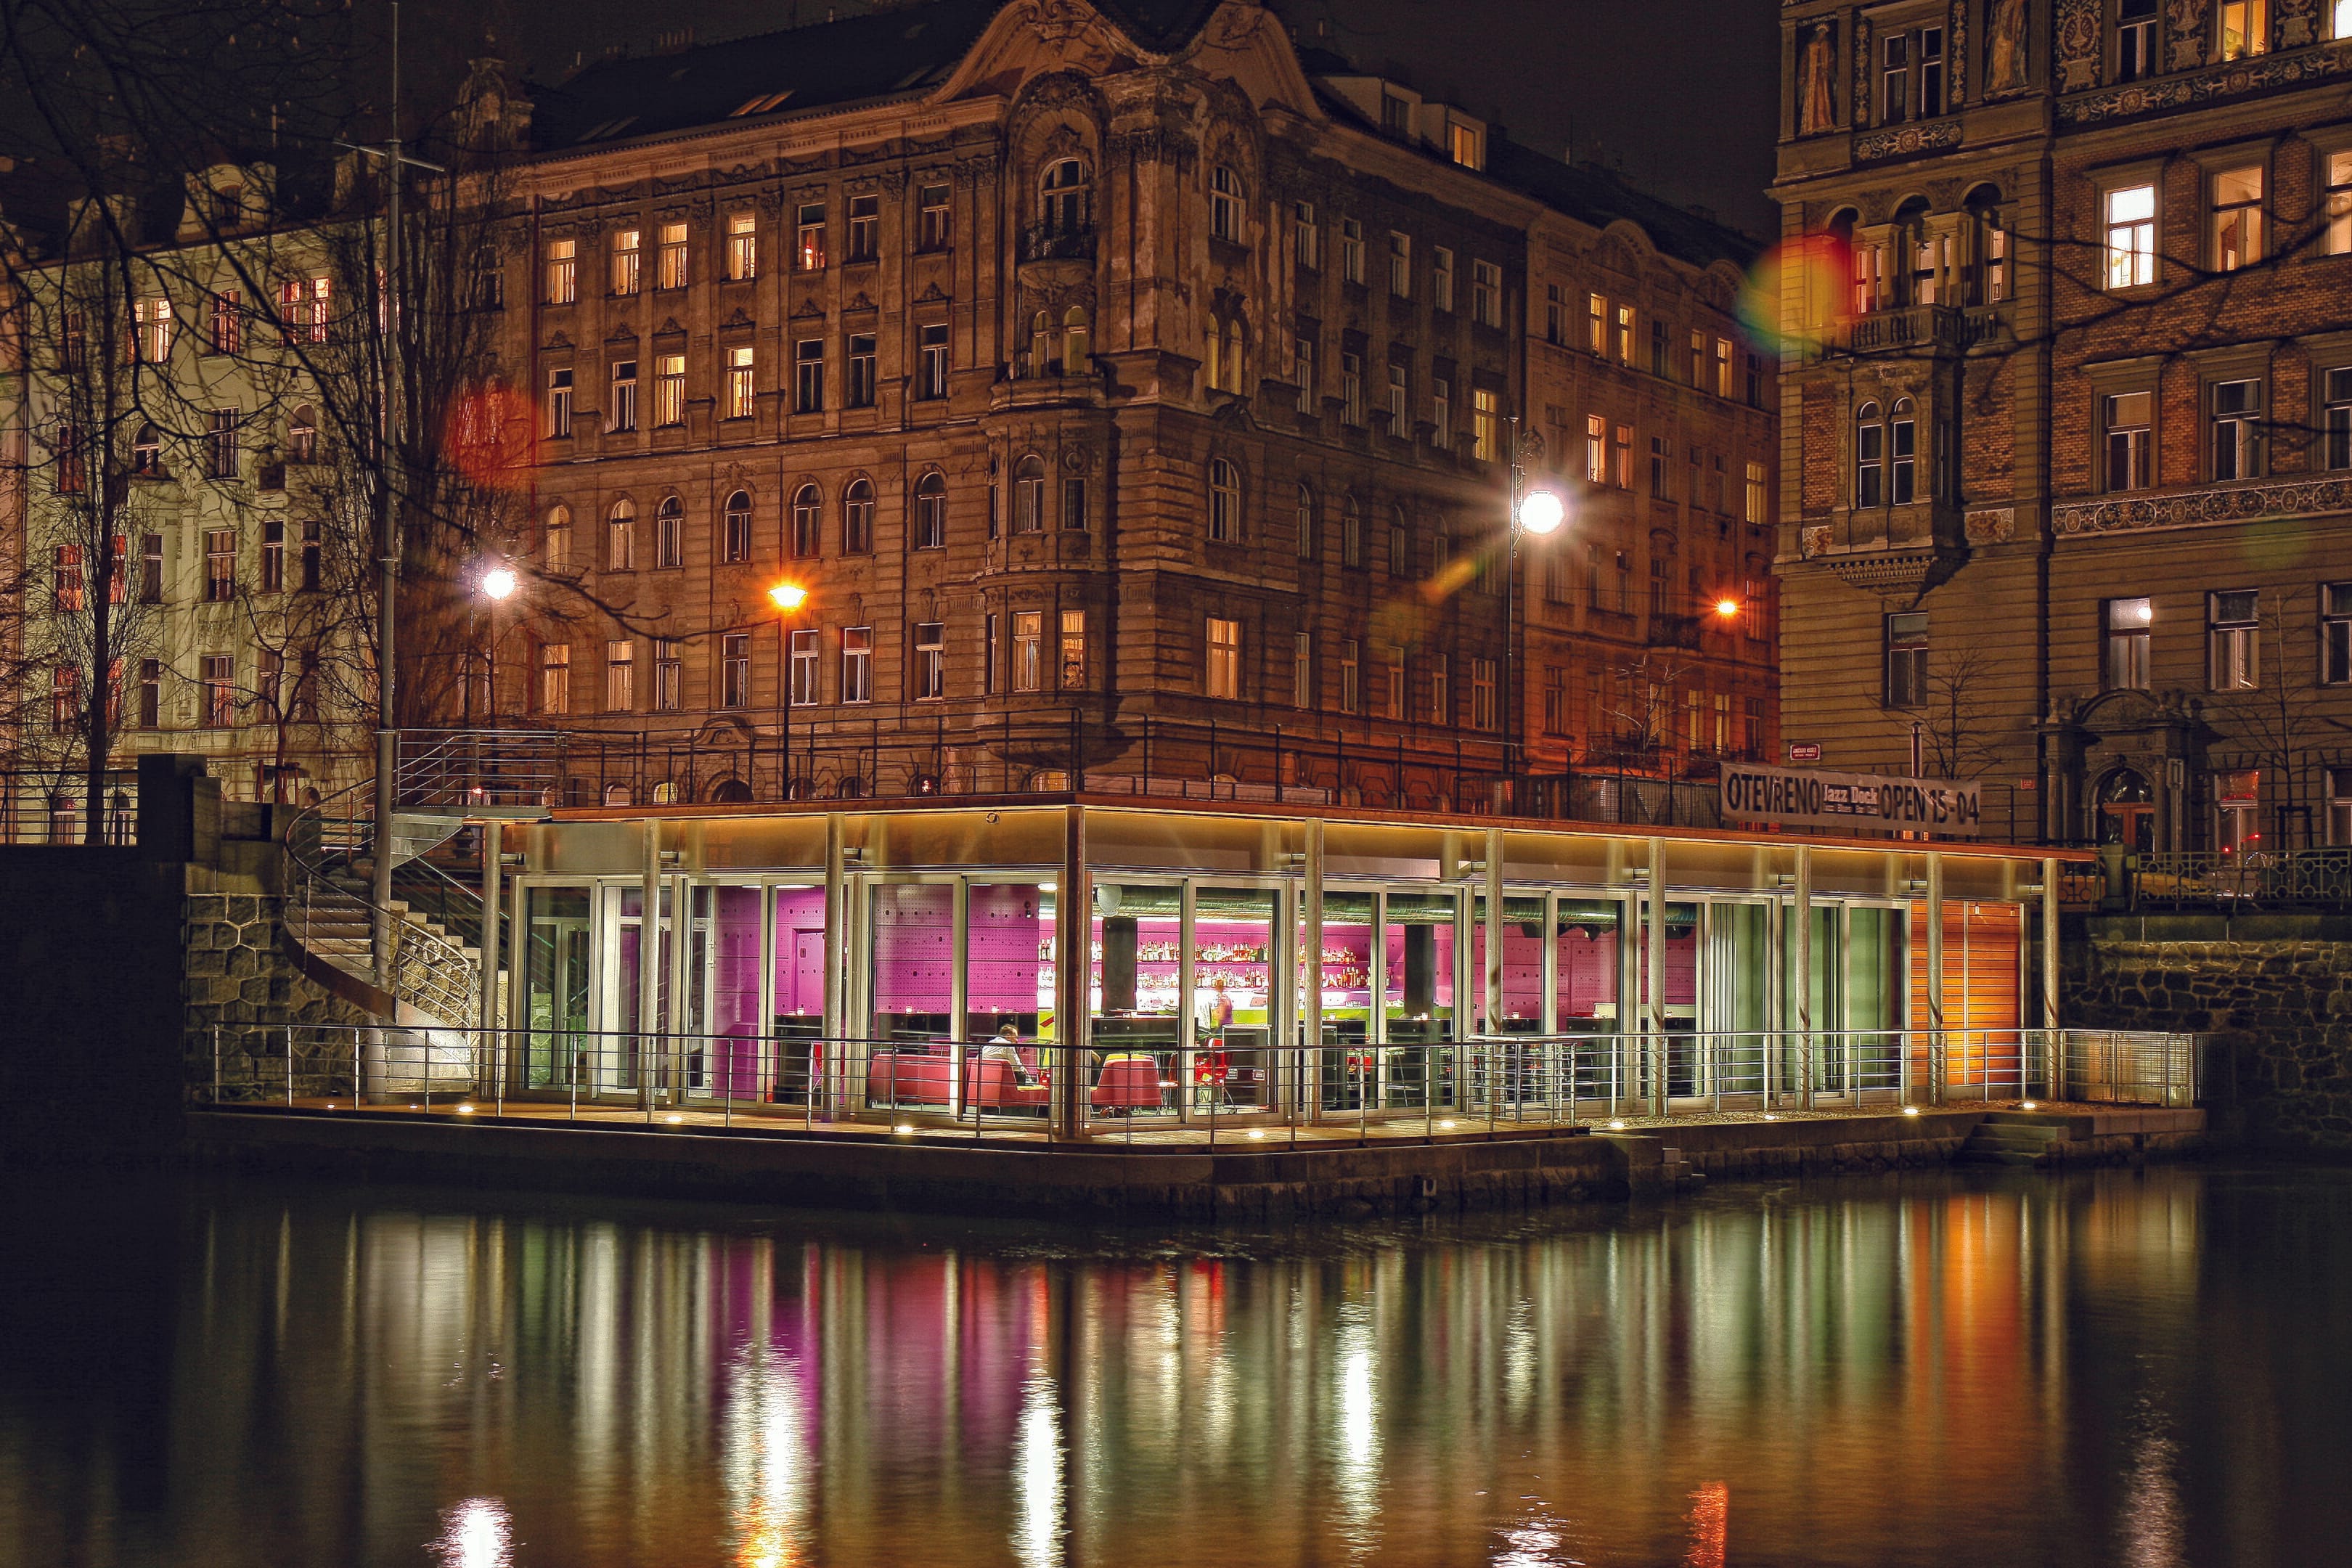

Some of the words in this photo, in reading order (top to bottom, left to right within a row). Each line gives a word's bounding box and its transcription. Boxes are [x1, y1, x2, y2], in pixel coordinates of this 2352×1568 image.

[1727, 772, 1821, 814] OTEVŘENO
[1823, 784, 1847, 802] Jazz
[1850, 786, 1878, 805] Dock
[1881, 784, 1926, 822] OPEN
[1930, 790, 1980, 825] 15-04
